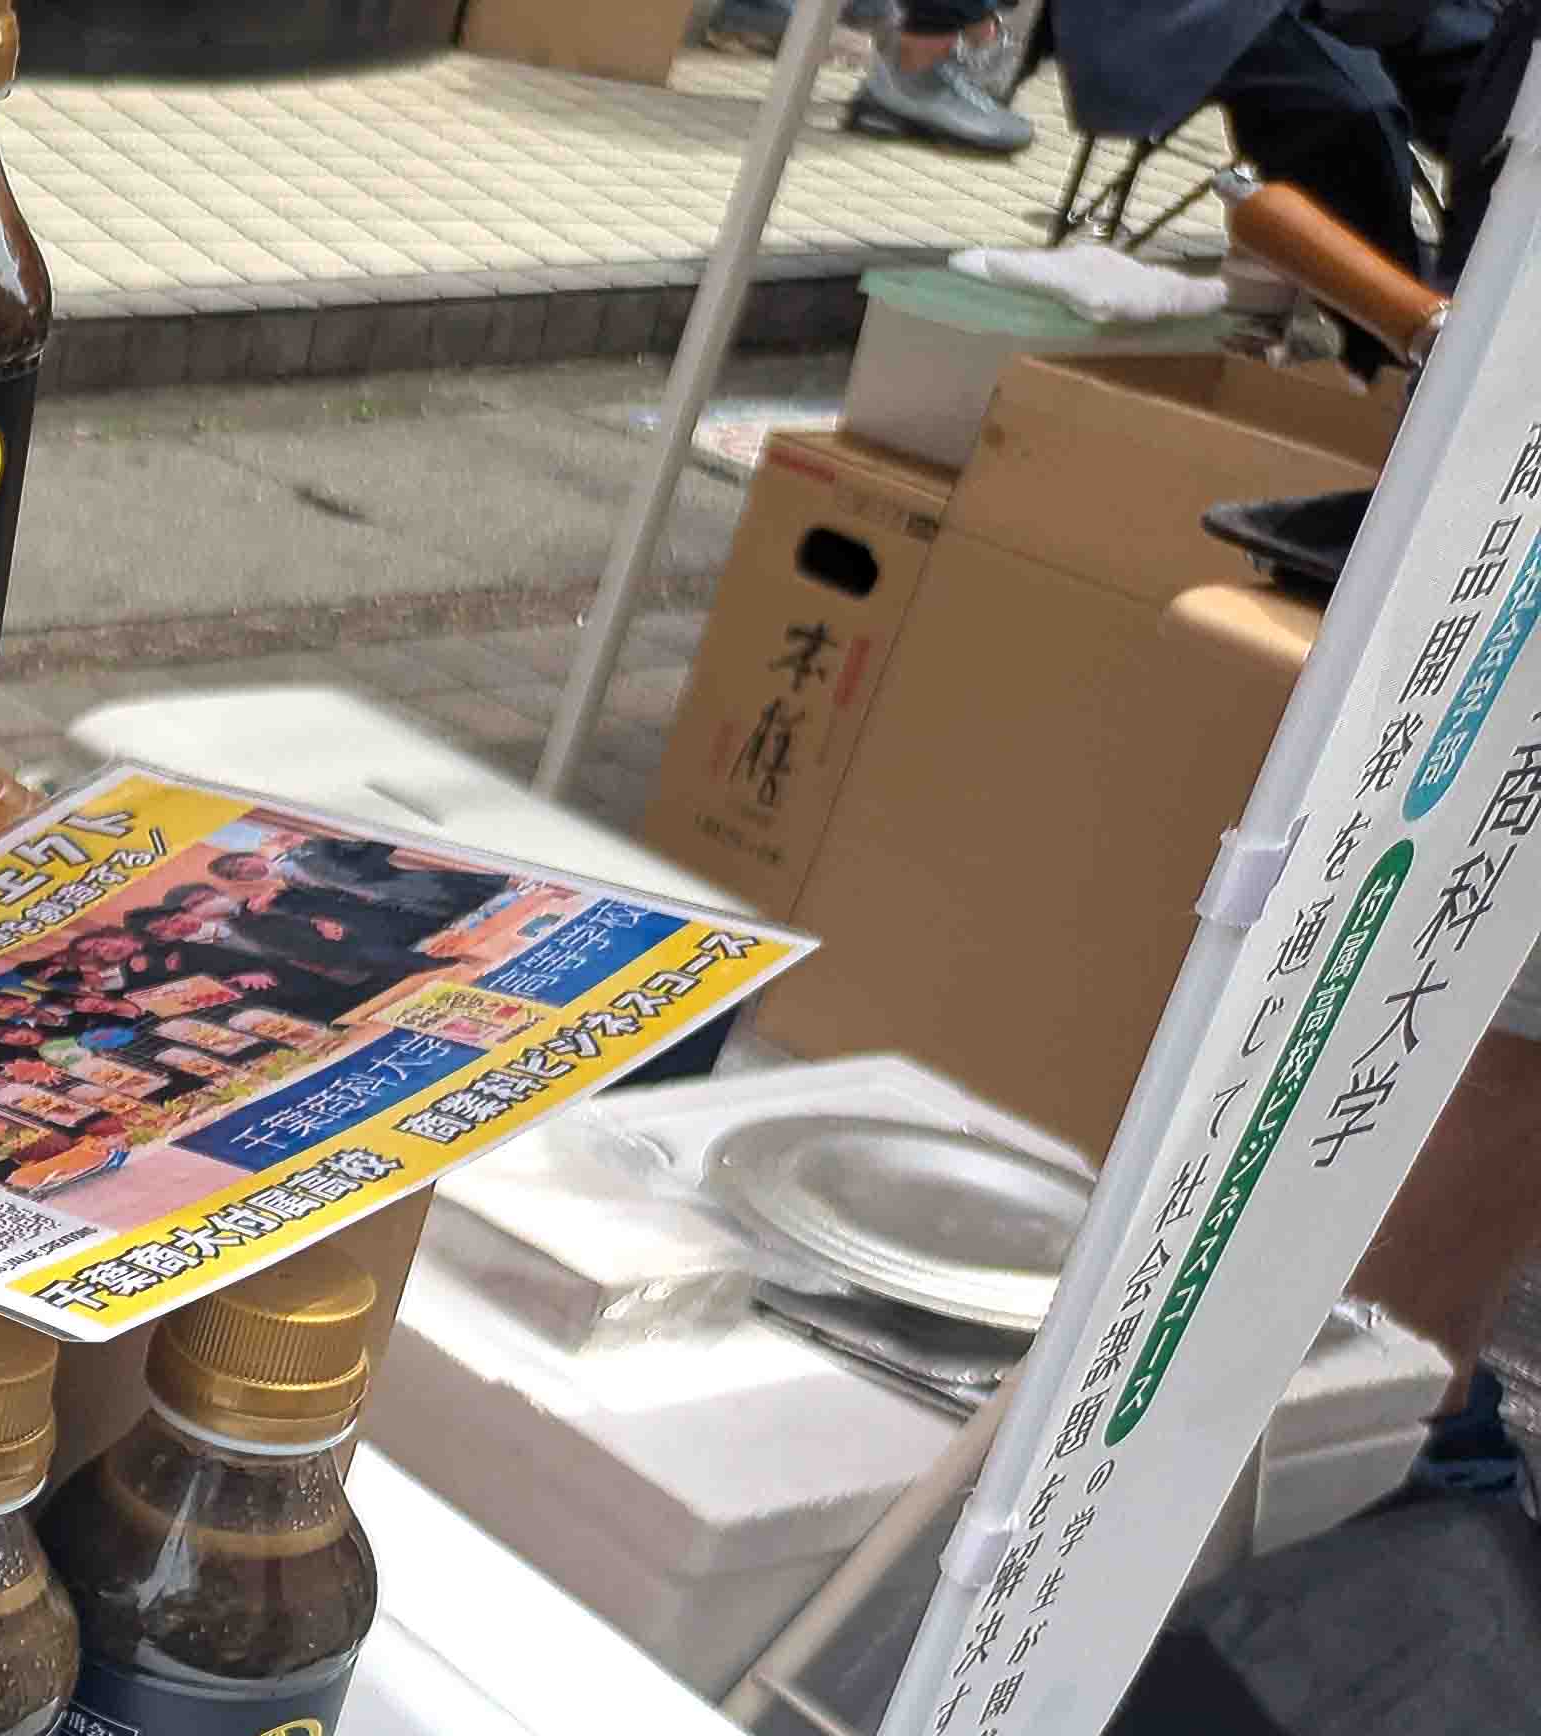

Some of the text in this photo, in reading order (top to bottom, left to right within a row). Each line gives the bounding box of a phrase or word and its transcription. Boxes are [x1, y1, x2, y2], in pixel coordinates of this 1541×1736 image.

[29, 931, 763, 1312] 千葉商大付属高校 商業科ビジネスコース
[230, 1034, 457, 1152] 千葉商科大学
[1118, 874, 1396, 1418] 付属高校ビジネスコース
[1309, 728, 1541, 1168] 商科大学
